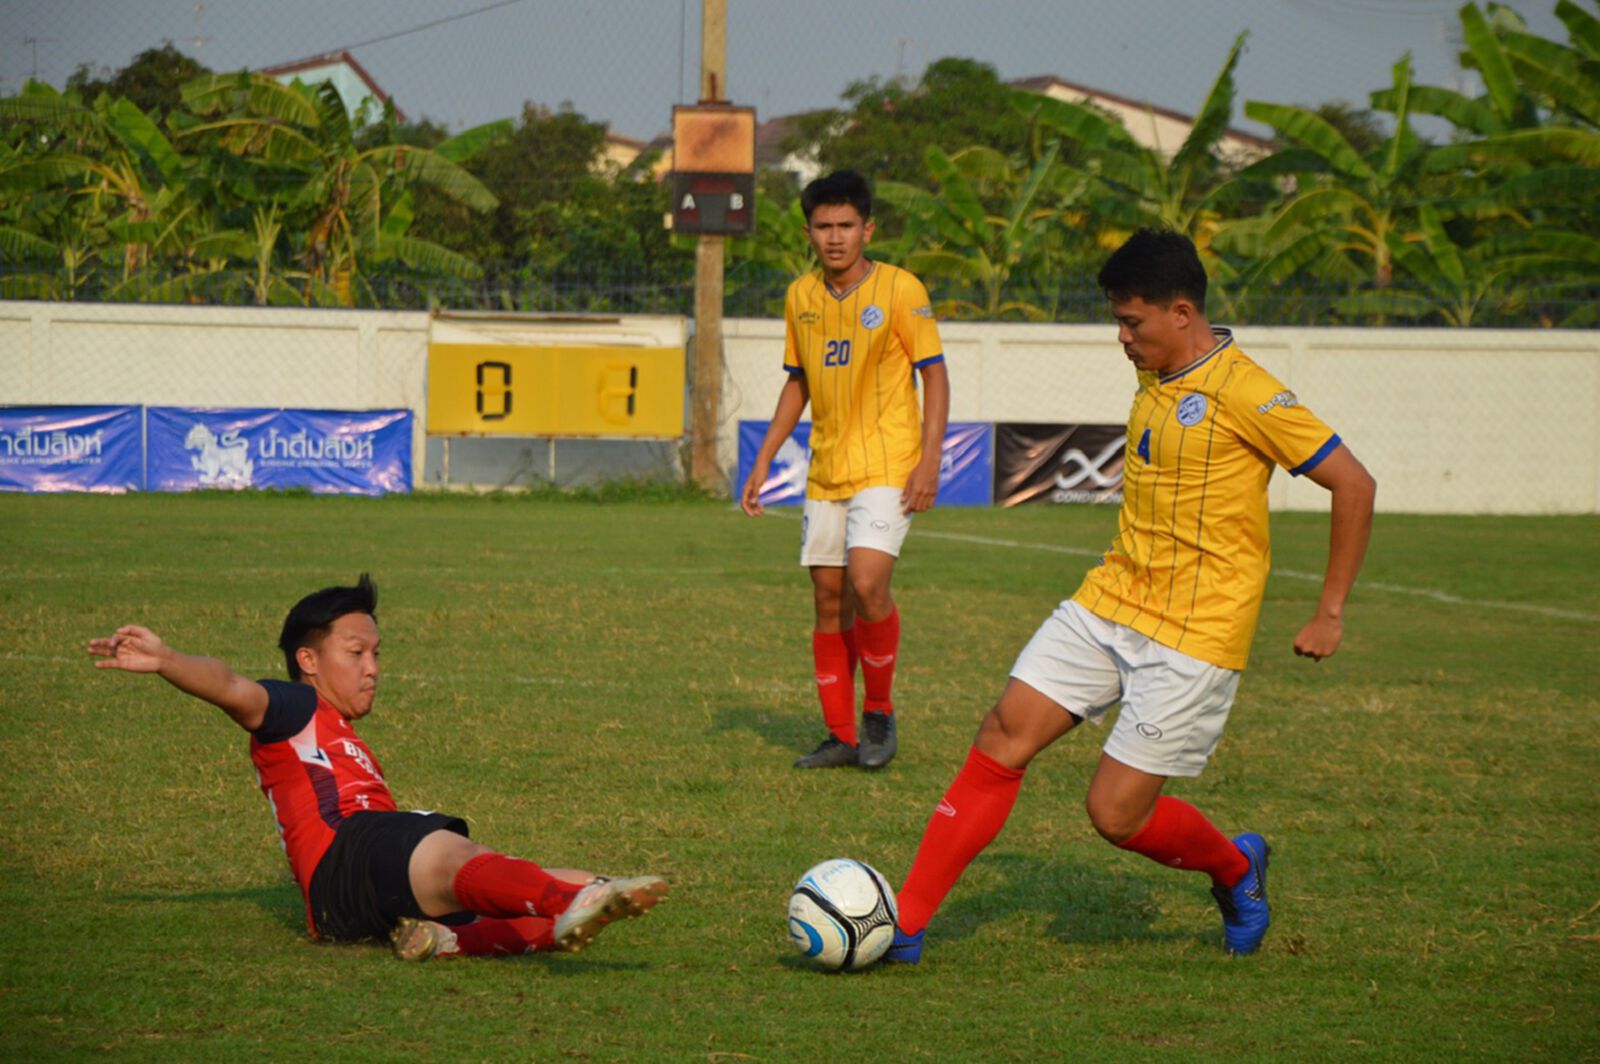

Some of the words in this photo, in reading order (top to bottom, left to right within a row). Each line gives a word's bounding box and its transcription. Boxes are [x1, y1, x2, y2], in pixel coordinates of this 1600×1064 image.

[681, 193, 696, 210] A
[730, 193, 744, 210] B
[824, 338, 850, 367] 20
[476, 361, 512, 421] 0
[259, 427, 375, 460] น้ำดื่มสิงห์
[1136, 428, 1152, 465] 4
